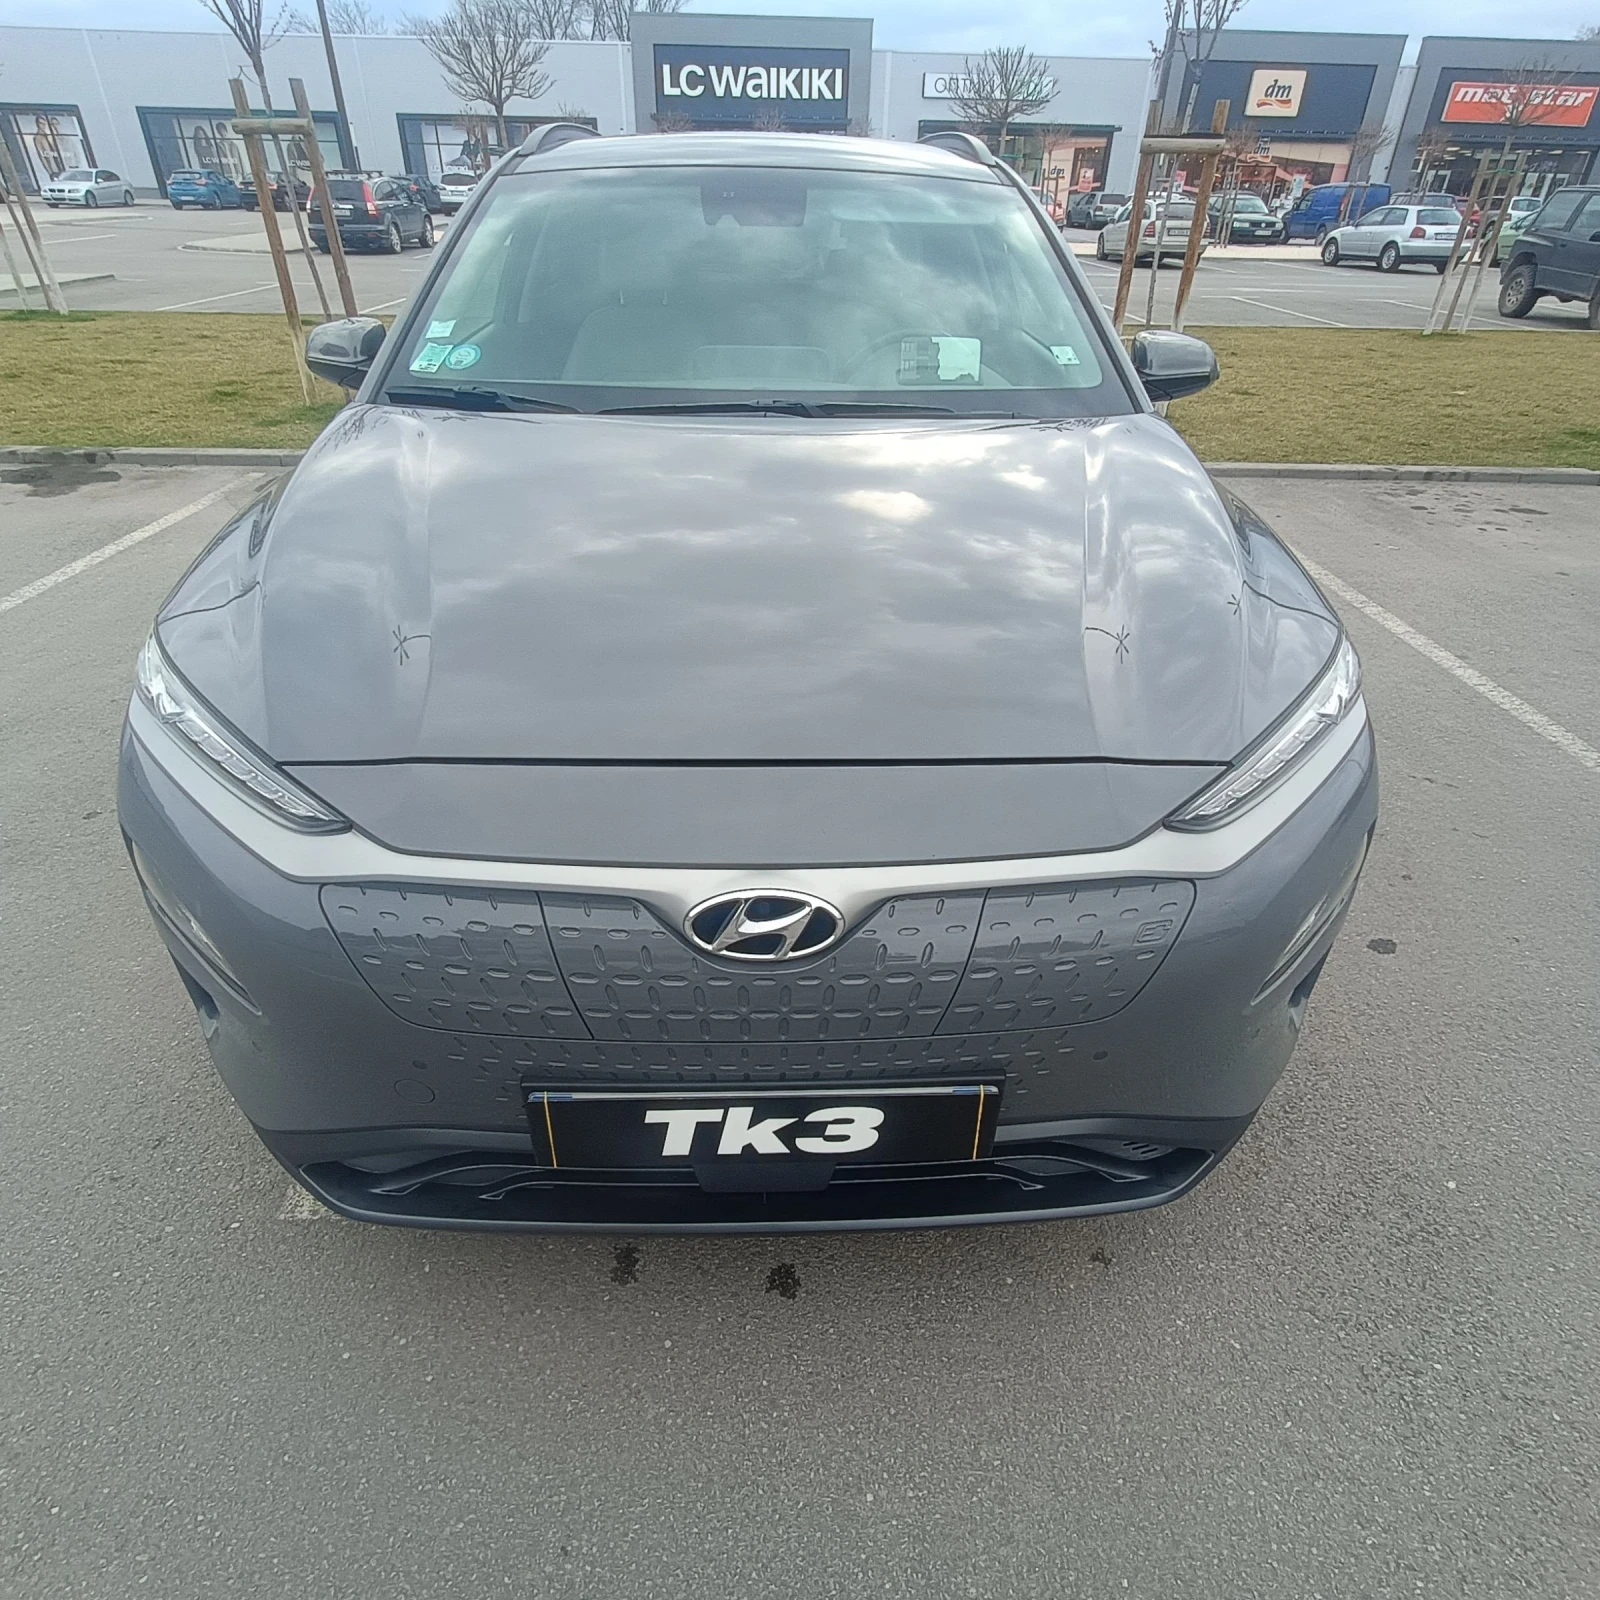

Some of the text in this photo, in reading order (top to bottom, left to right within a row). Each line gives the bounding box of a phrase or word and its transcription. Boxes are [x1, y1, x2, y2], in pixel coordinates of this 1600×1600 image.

[662, 63, 705, 97] LC
[1264, 79, 1292, 99] dm
[1254, 144, 1270, 155] dm
[1050, 165, 1065, 175] dm
[644, 1106, 885, 1157] Tk3
